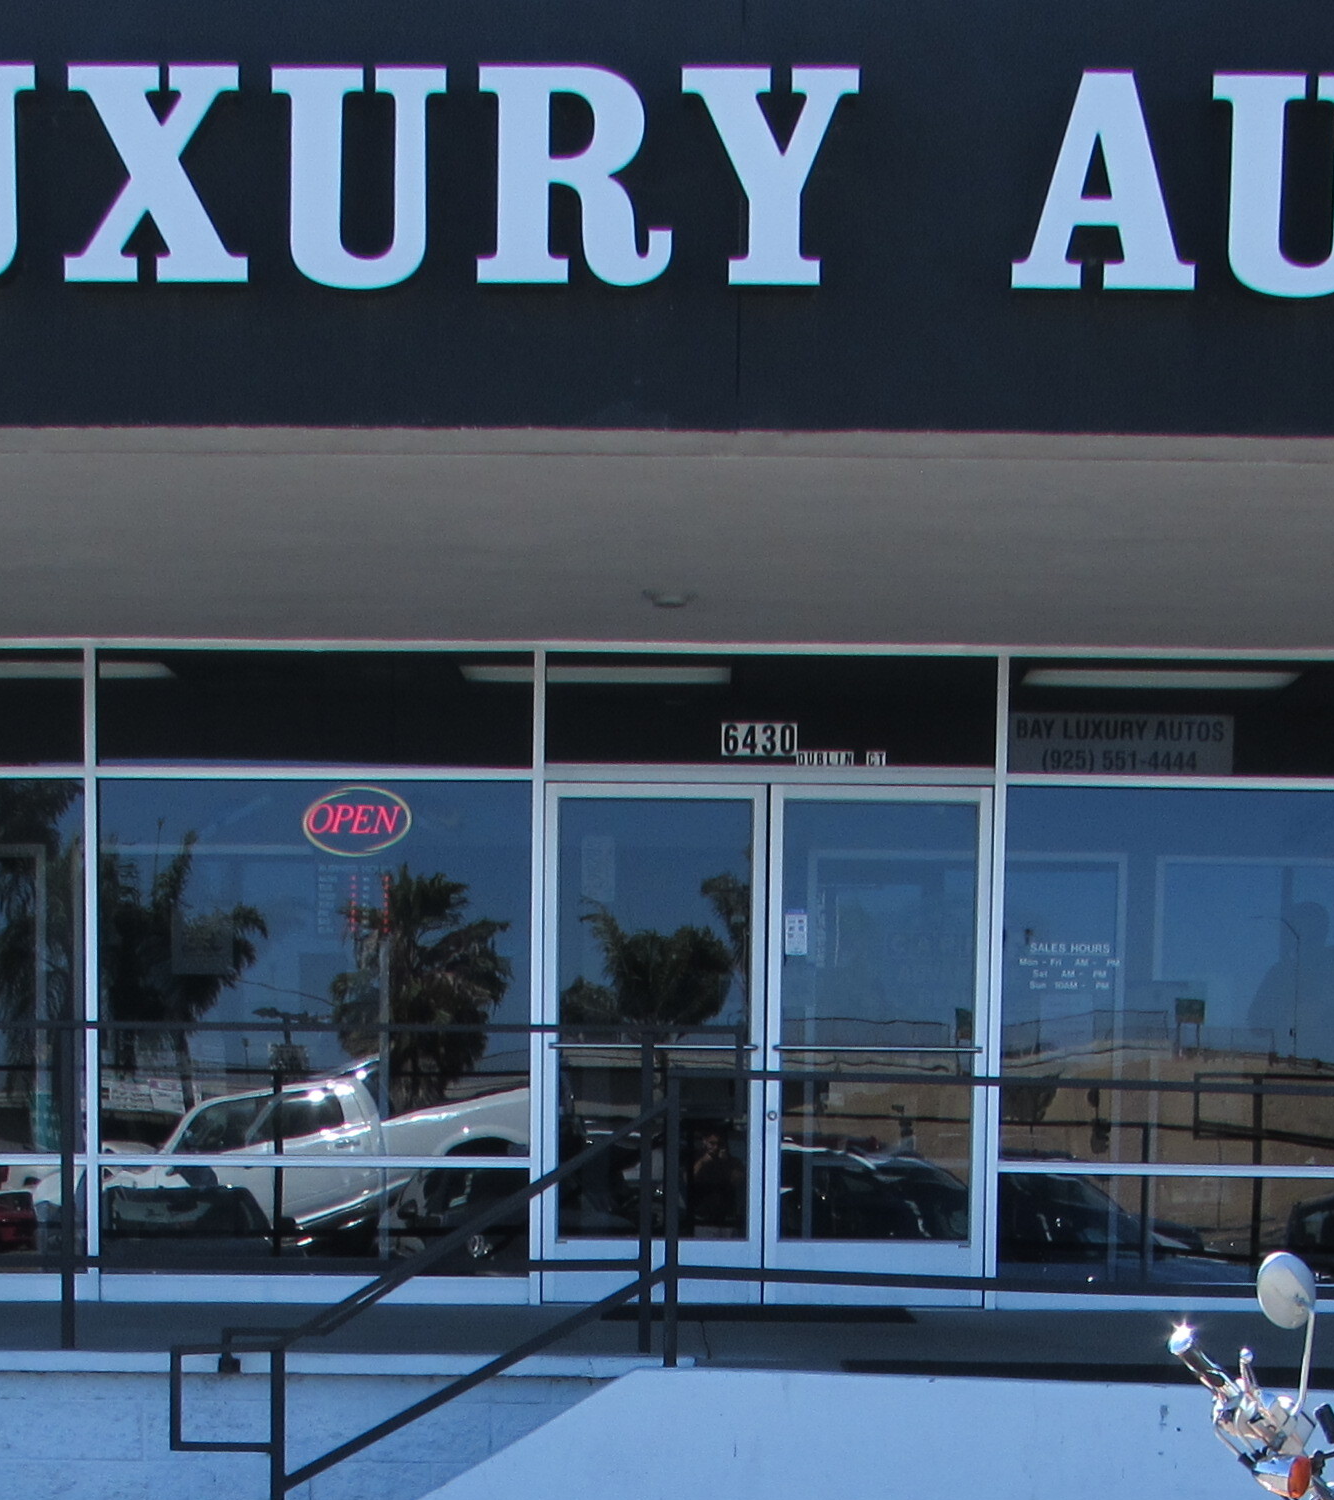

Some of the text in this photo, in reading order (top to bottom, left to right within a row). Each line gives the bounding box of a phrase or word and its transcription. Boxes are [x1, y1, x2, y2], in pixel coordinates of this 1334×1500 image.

[723, 723, 795, 756] 6430
[1017, 718, 1224, 742] BAY LUXURY AUTOS
[798, 752, 884, 766] DUBLIN CT
[1042, 750, 1198, 773] (925) 551-4444
[308, 803, 401, 834] OPEN
[1030, 943, 1110, 954] SALES HOURS
